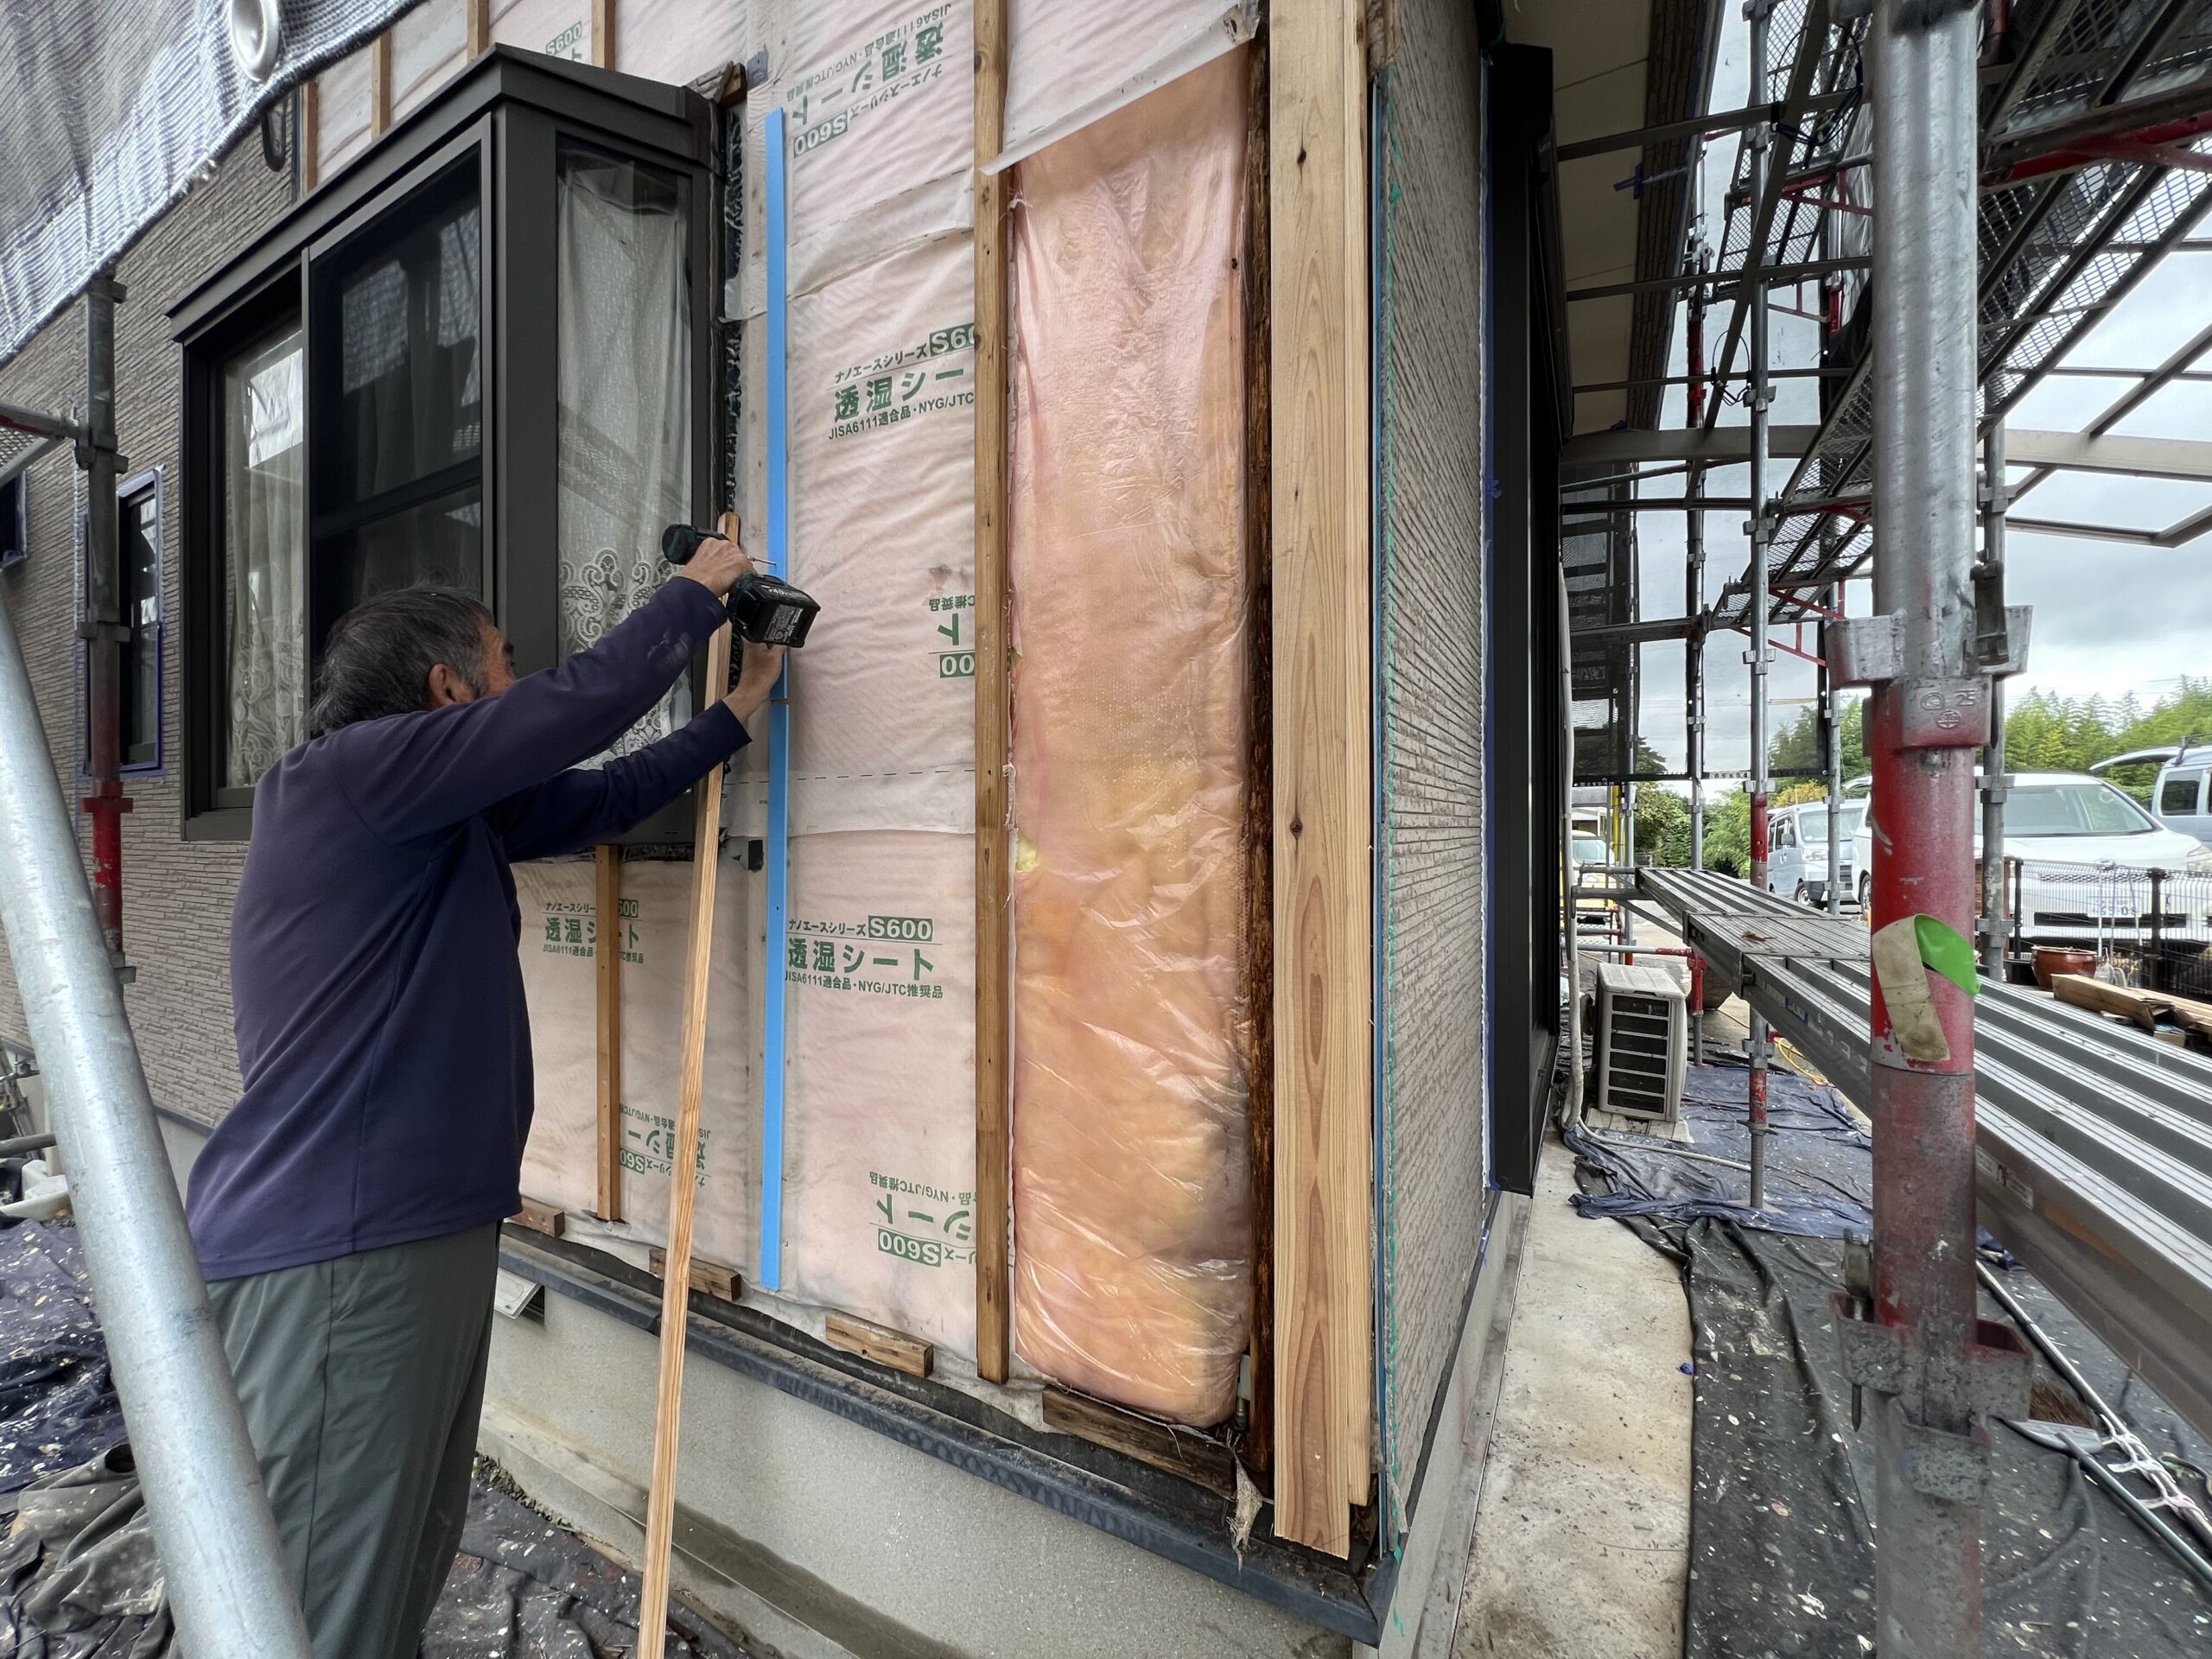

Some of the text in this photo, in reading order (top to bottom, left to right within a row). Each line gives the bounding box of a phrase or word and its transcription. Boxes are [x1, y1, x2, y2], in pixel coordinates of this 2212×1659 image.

[546, 22, 582, 55] S600
[792, 22, 944, 125] 透湿シート
[794, 112, 847, 157] S600
[835, 343, 927, 384] ナノエースシリーズ
[835, 368, 963, 423] 透湿シー
[788, 916, 932, 941] ナノエースシリーズ S600
[788, 938, 934, 980] 透湿シート
[876, 1193, 971, 1241] シート
[878, 1229, 941, 1267] S600
